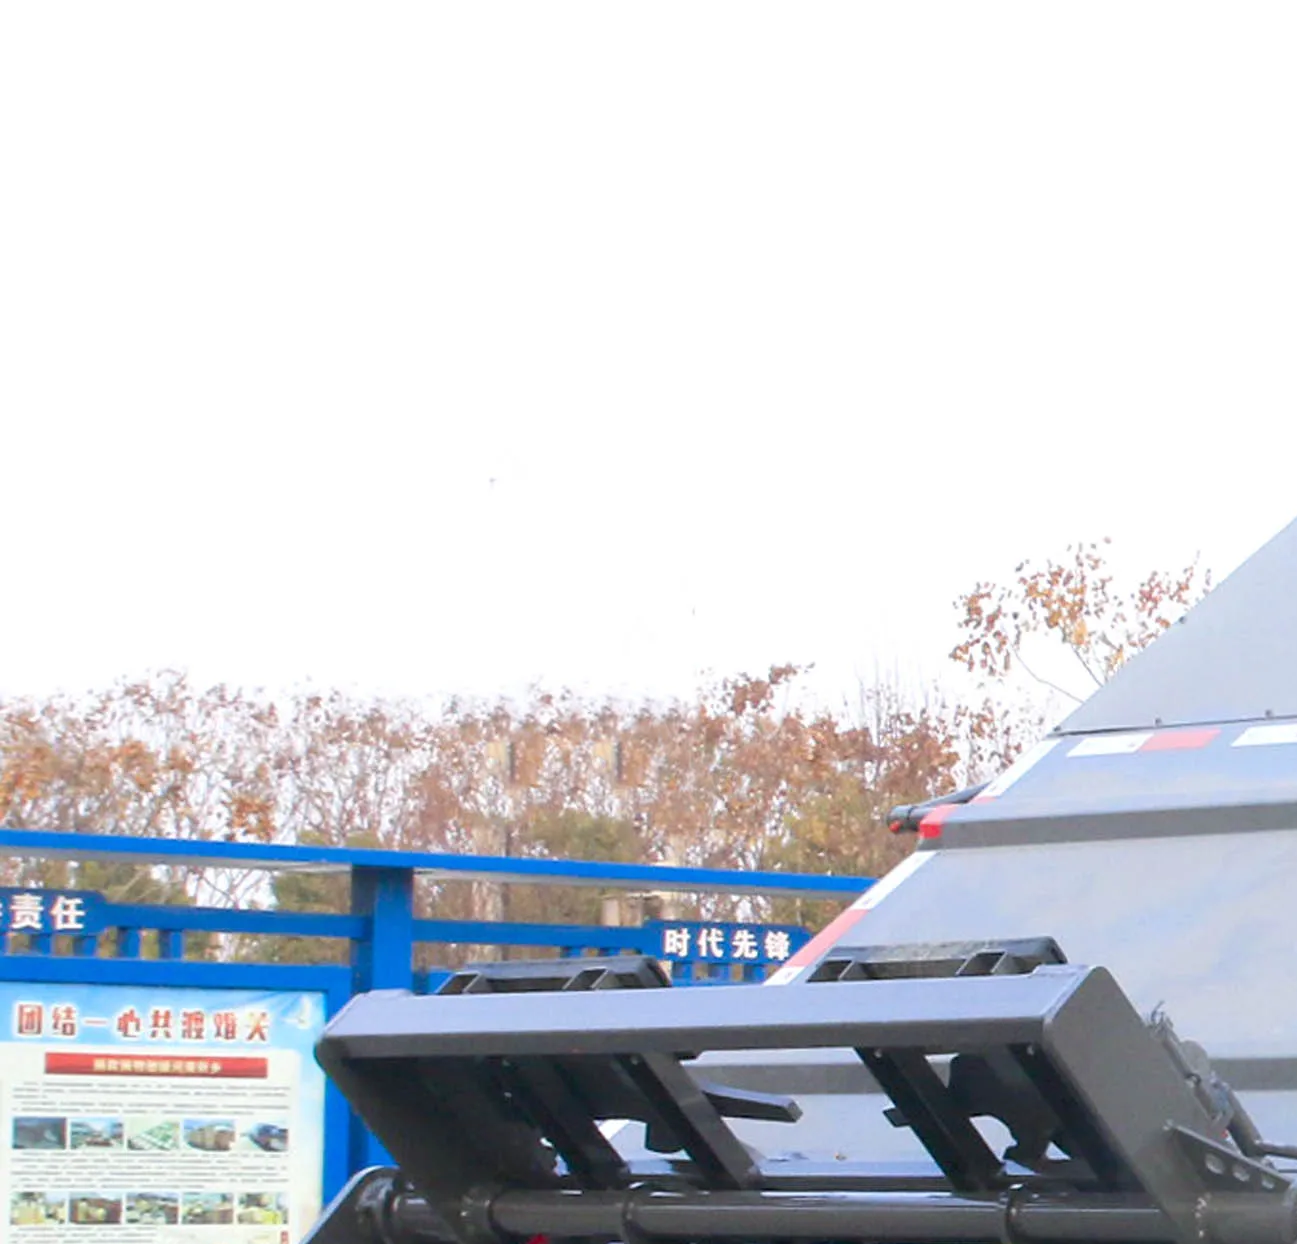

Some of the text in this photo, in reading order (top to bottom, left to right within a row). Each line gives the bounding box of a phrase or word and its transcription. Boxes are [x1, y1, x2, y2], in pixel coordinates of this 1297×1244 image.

[0, 893, 86, 931] 责任
[664, 927, 790, 961] 时代先锋
[17, 1003, 270, 1042] 团结一心共渡难关
